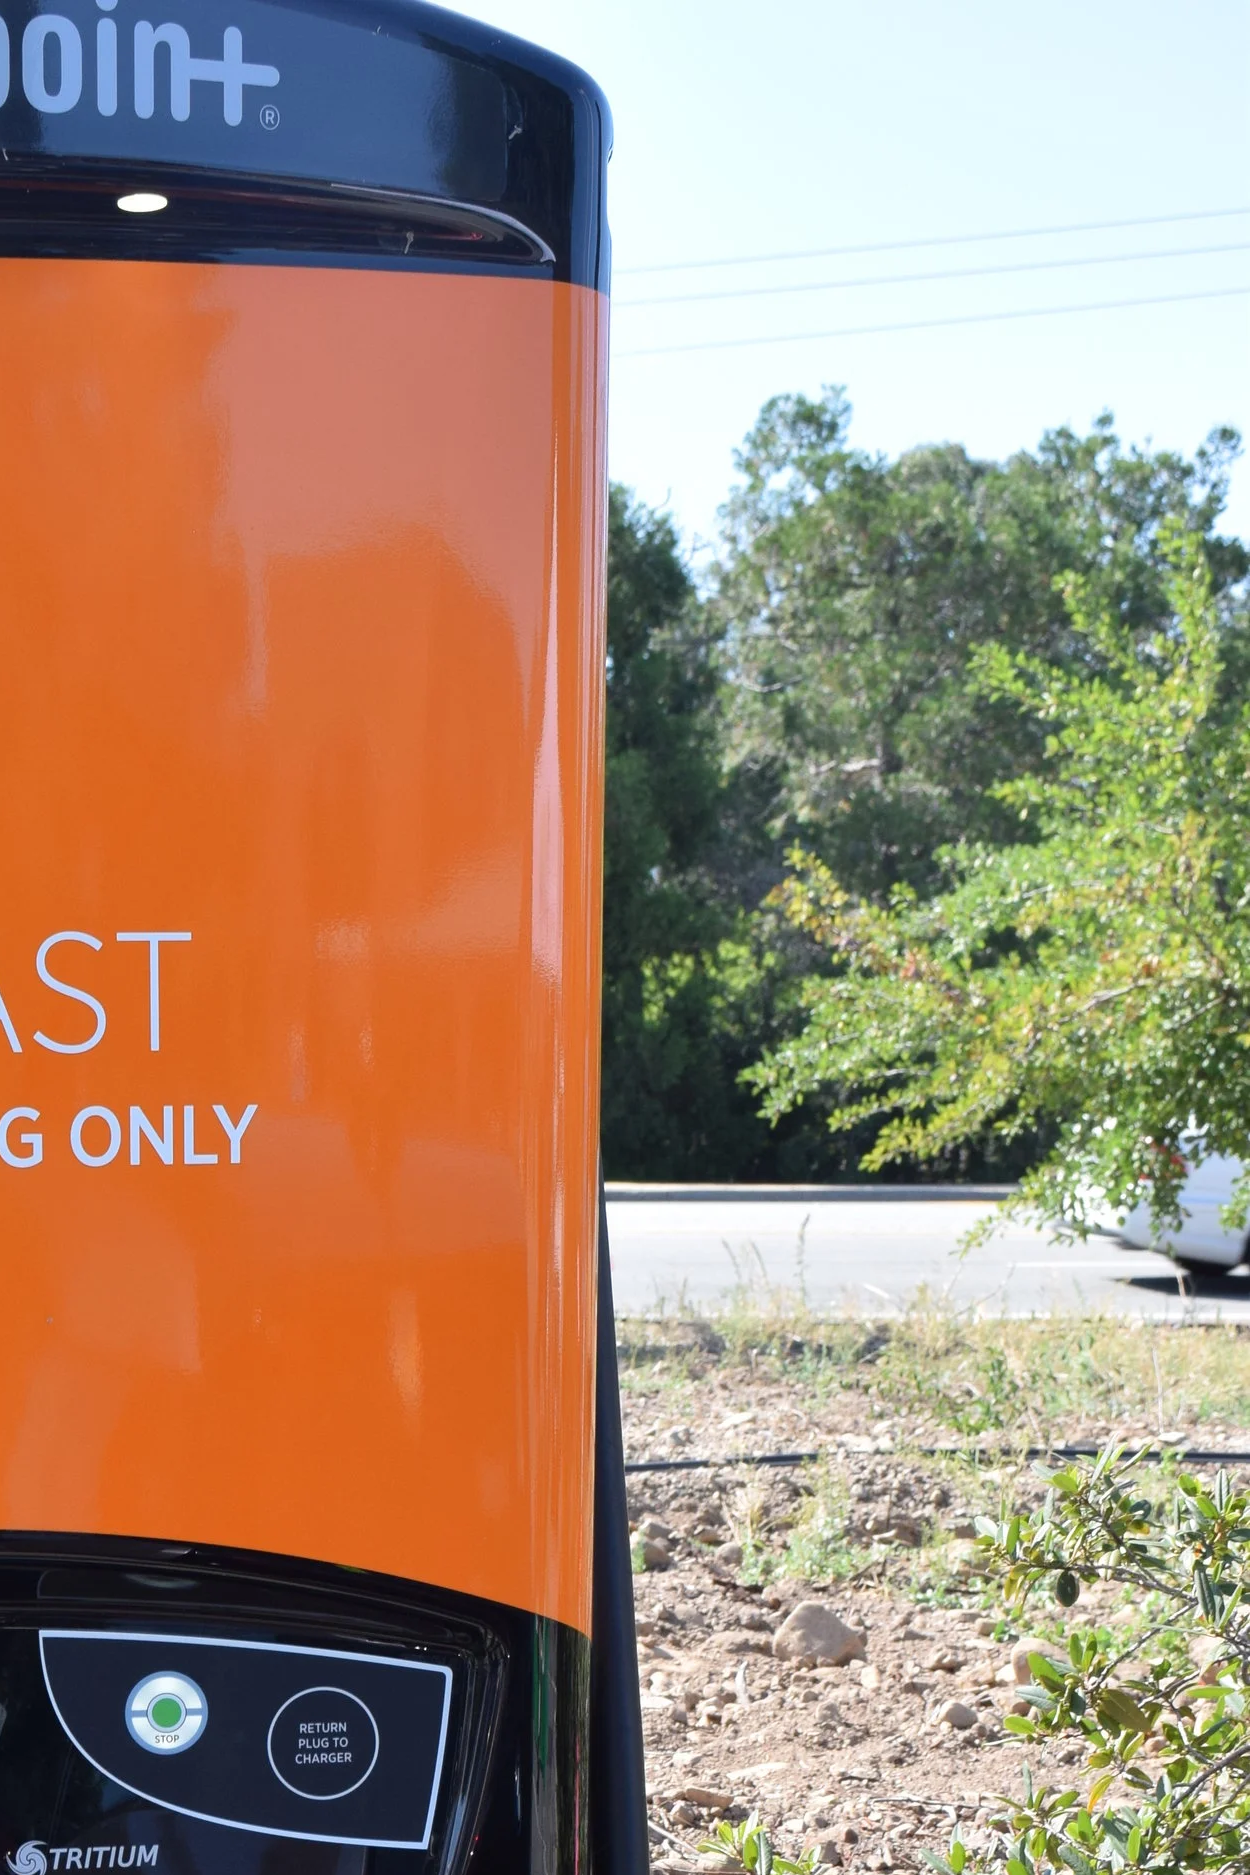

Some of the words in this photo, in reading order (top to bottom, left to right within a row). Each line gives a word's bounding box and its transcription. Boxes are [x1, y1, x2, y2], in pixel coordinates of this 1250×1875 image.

[69, 1104, 258, 1167] ONLY
[299, 1722, 347, 1734] RETURN
[154, 1734, 180, 1744] STOP
[298, 1737, 330, 1749] PLUG
[333, 1737, 349, 1748] TO
[295, 1752, 352, 1765] CHARGER
[50, 1844, 159, 1871] TRITIUM
